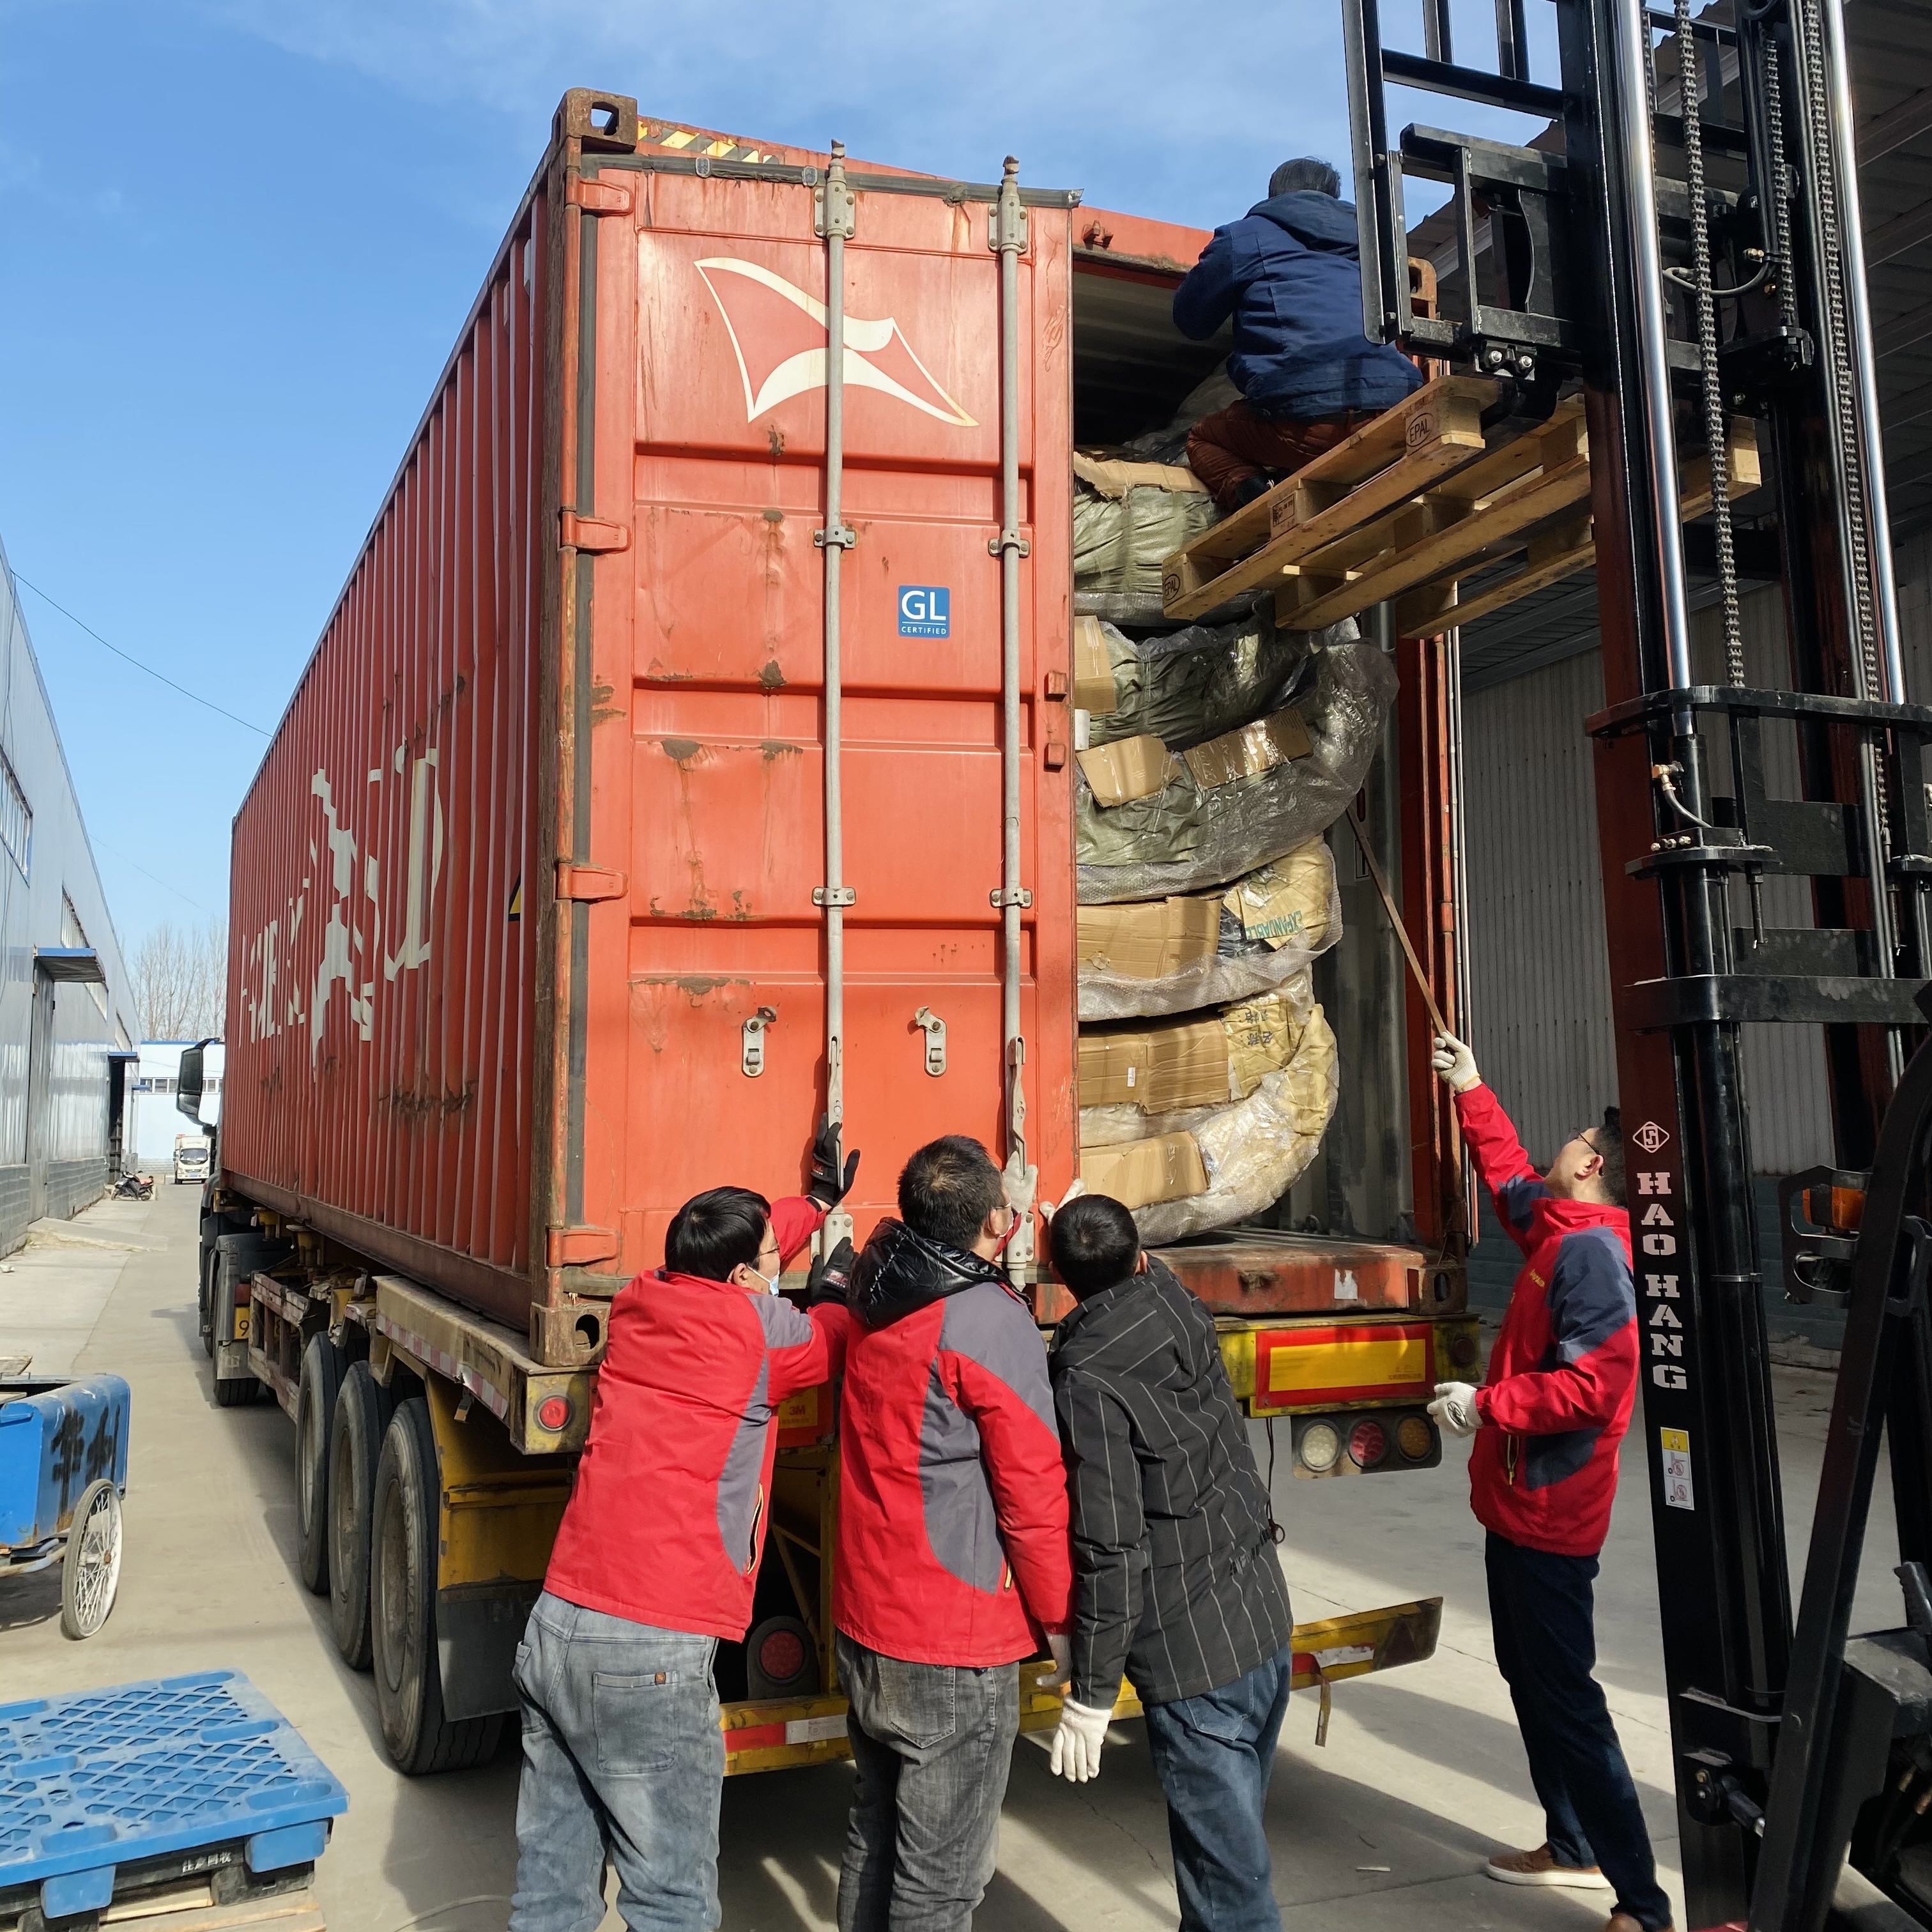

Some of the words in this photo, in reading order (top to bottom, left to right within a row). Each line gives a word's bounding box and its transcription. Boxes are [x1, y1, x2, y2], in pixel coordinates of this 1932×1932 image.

[1409, 418, 1430, 443] EPAL
[1164, 578, 1177, 597] EPAL
[901, 590, 946, 620] GL
[901, 626, 946, 634] CERTIFIED
[1245, 910, 1303, 940] EXPANDABLE
[1636, 1172, 1676, 1255] HAO
[1645, 1274, 1687, 1390] HANG
[789, 1405, 806, 1416] 3M
